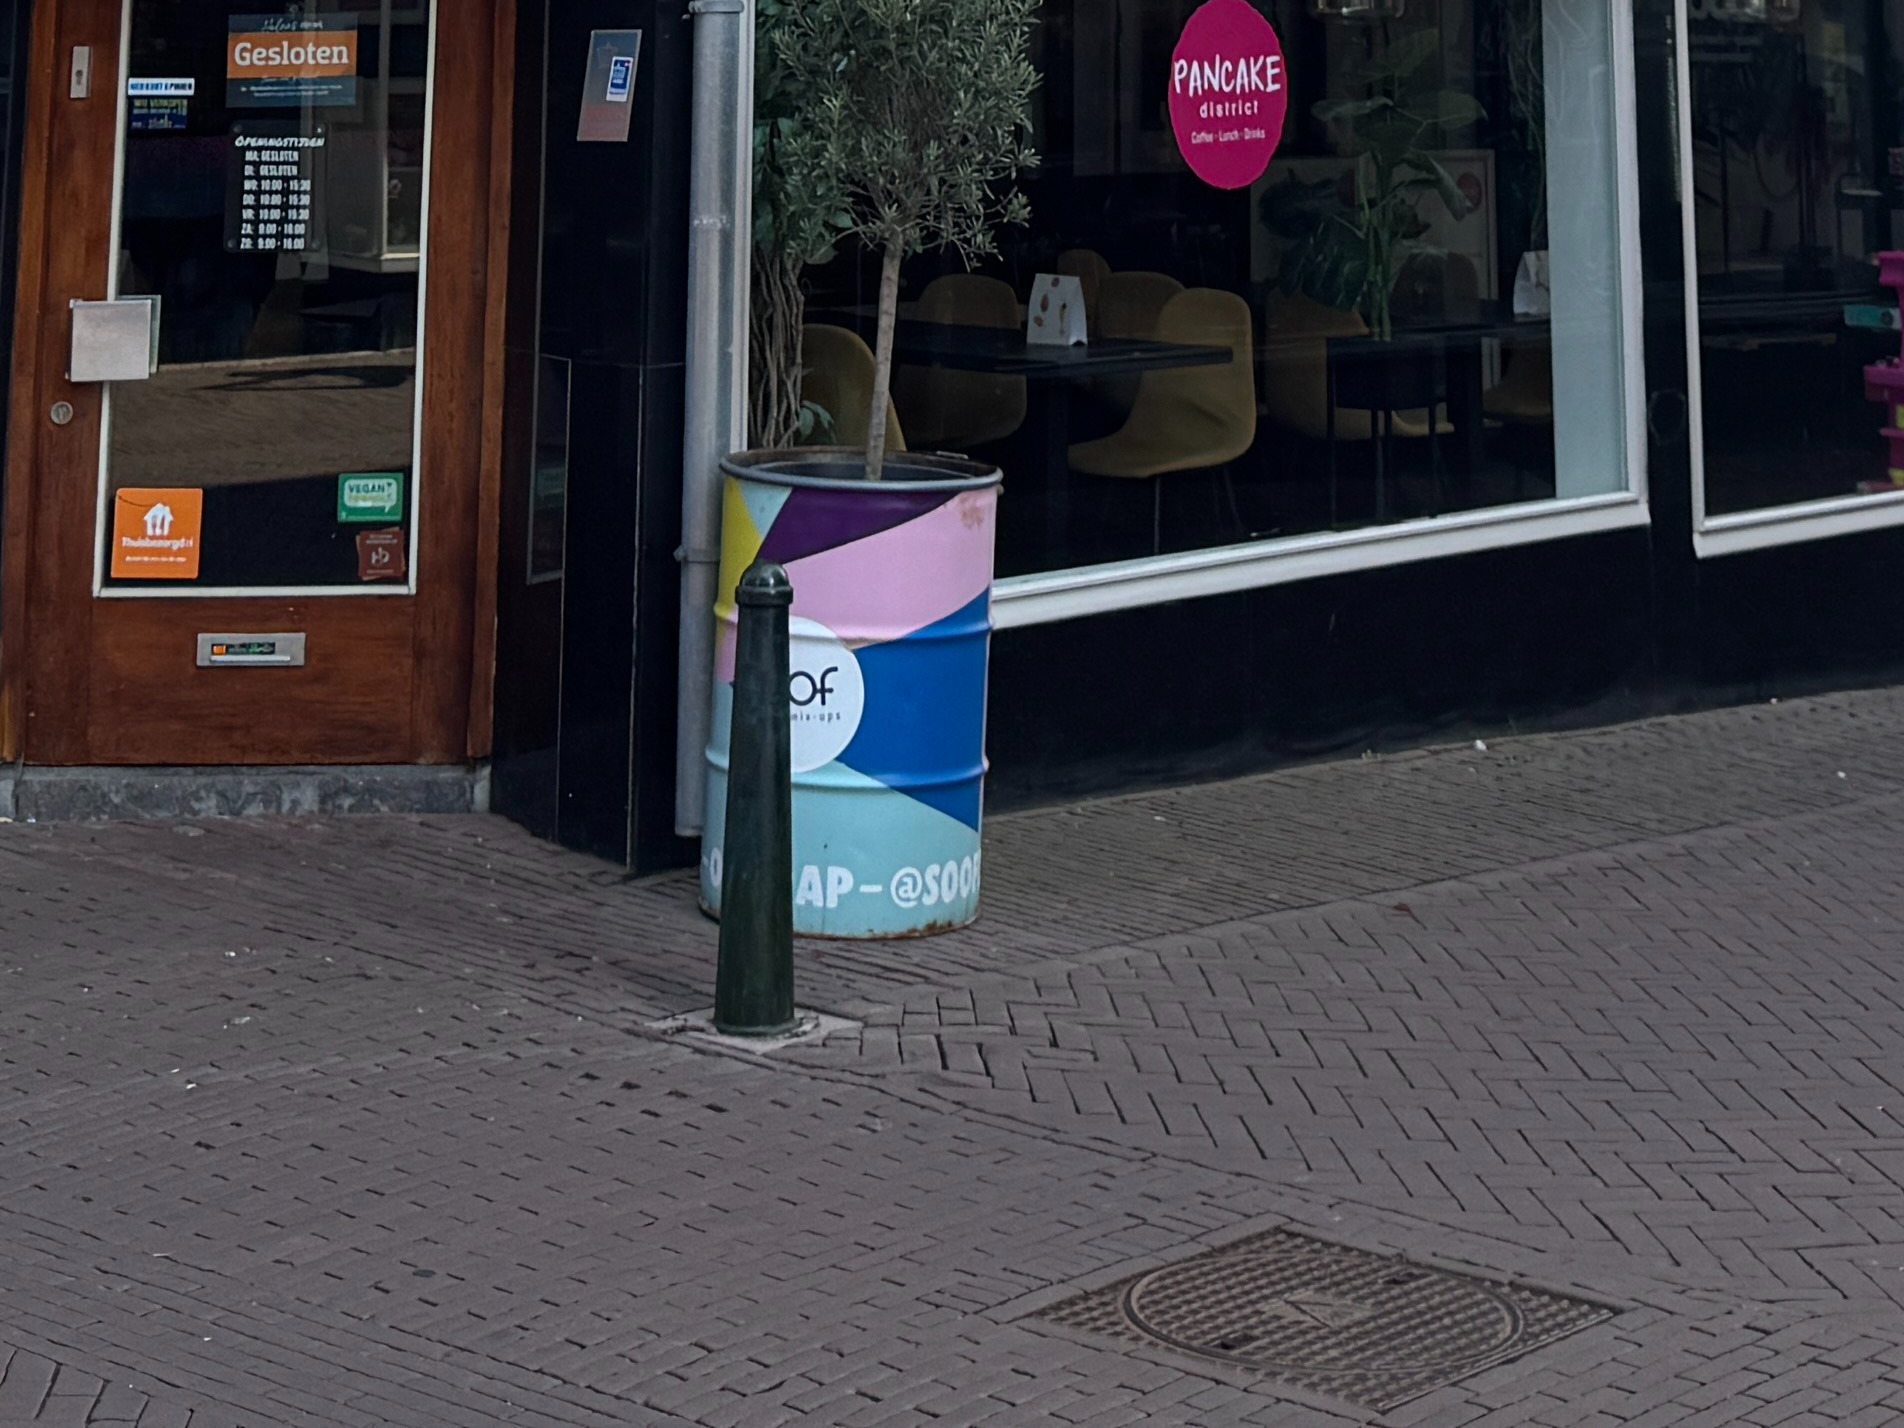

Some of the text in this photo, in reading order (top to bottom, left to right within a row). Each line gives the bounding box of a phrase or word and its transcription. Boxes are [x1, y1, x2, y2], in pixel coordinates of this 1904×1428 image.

[235, 41, 349, 65] Gesloten
[1174, 54, 1281, 97] PANCAKE
[1200, 100, 1258, 118] district
[348, 484, 385, 493] VEGAN
